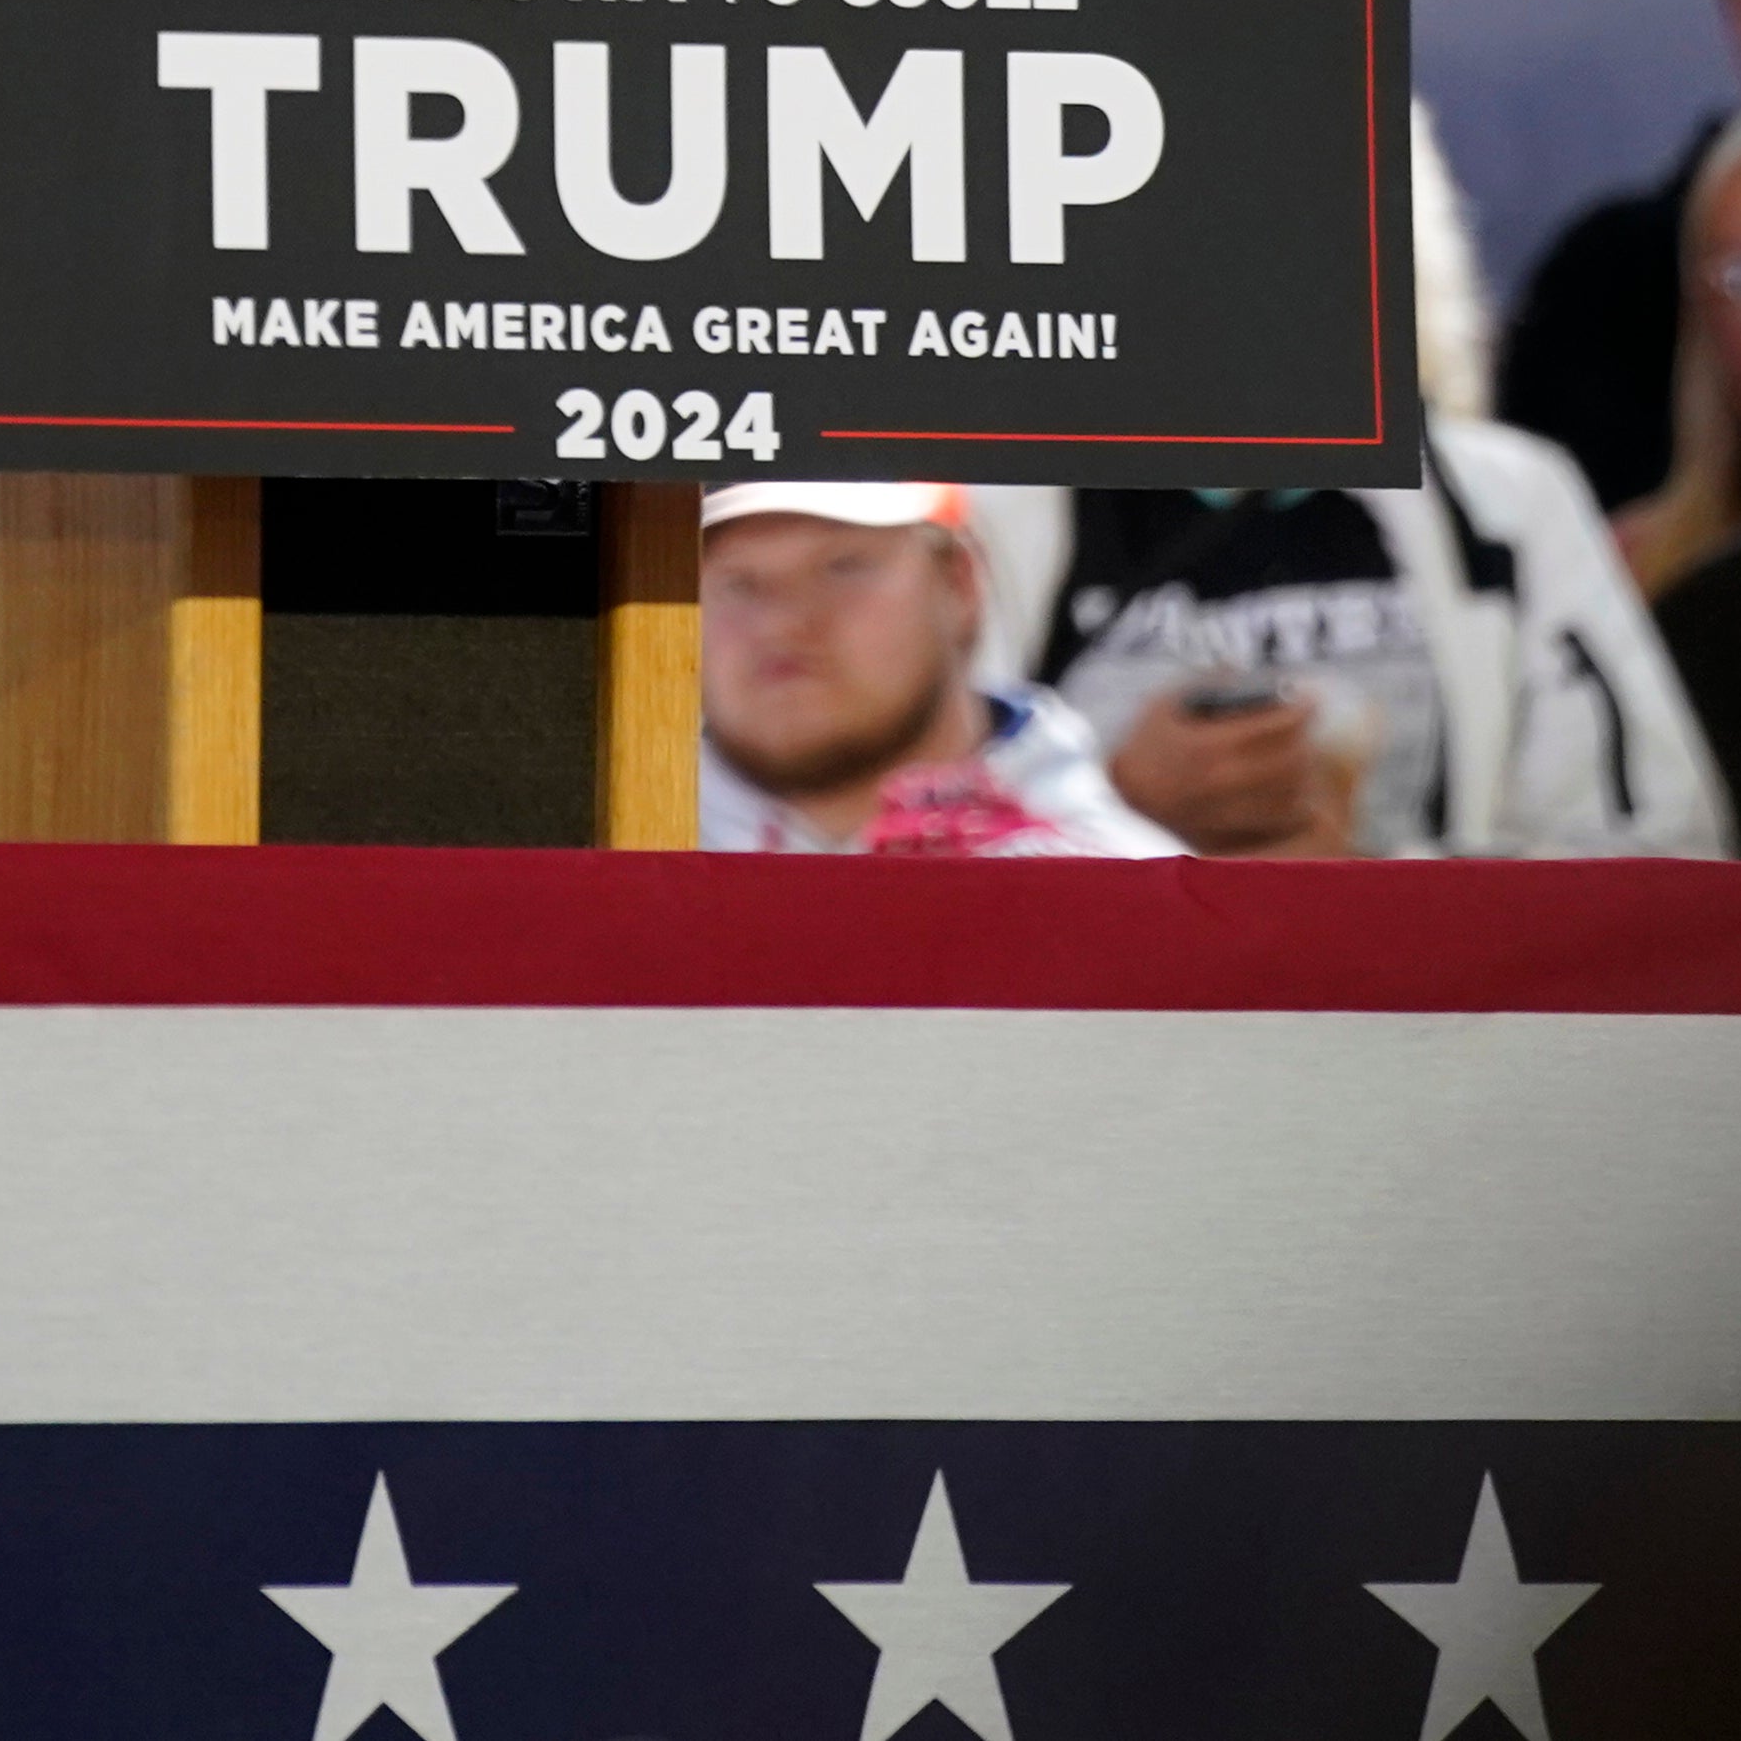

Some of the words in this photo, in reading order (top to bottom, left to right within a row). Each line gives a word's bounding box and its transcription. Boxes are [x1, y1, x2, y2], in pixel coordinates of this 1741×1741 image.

[157, 31, 1165, 265] TRUMP
[212, 296, 380, 348] MAKE
[399, 300, 673, 353] AMERICA
[692, 305, 887, 356] GREAT
[907, 309, 1118, 360] AGAIN!
[555, 388, 781, 462] 2024
